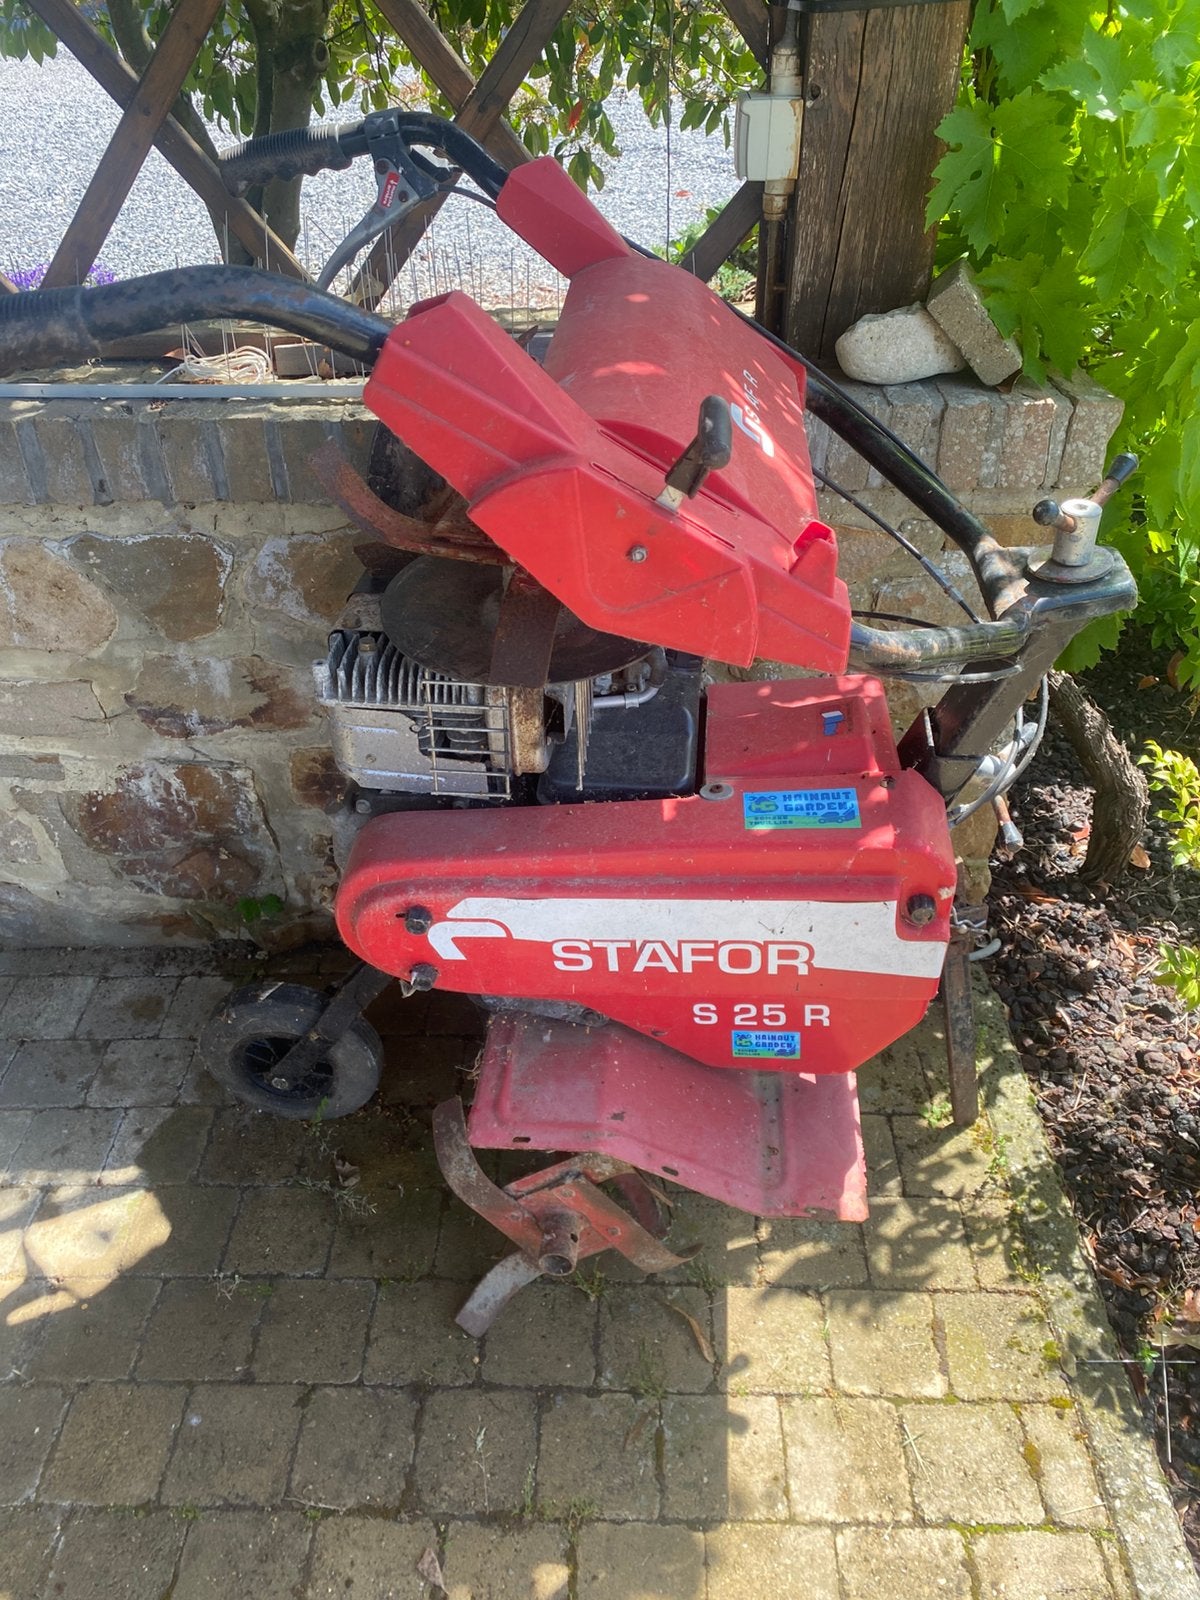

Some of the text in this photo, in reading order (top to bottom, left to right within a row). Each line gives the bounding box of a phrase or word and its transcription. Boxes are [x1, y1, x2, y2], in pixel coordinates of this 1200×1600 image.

[783, 791, 852, 802] HAINAUT
[783, 802, 848, 812] GARDEN
[552, 940, 810, 975] STAFOR
[693, 1003, 830, 1027] S 25 R
